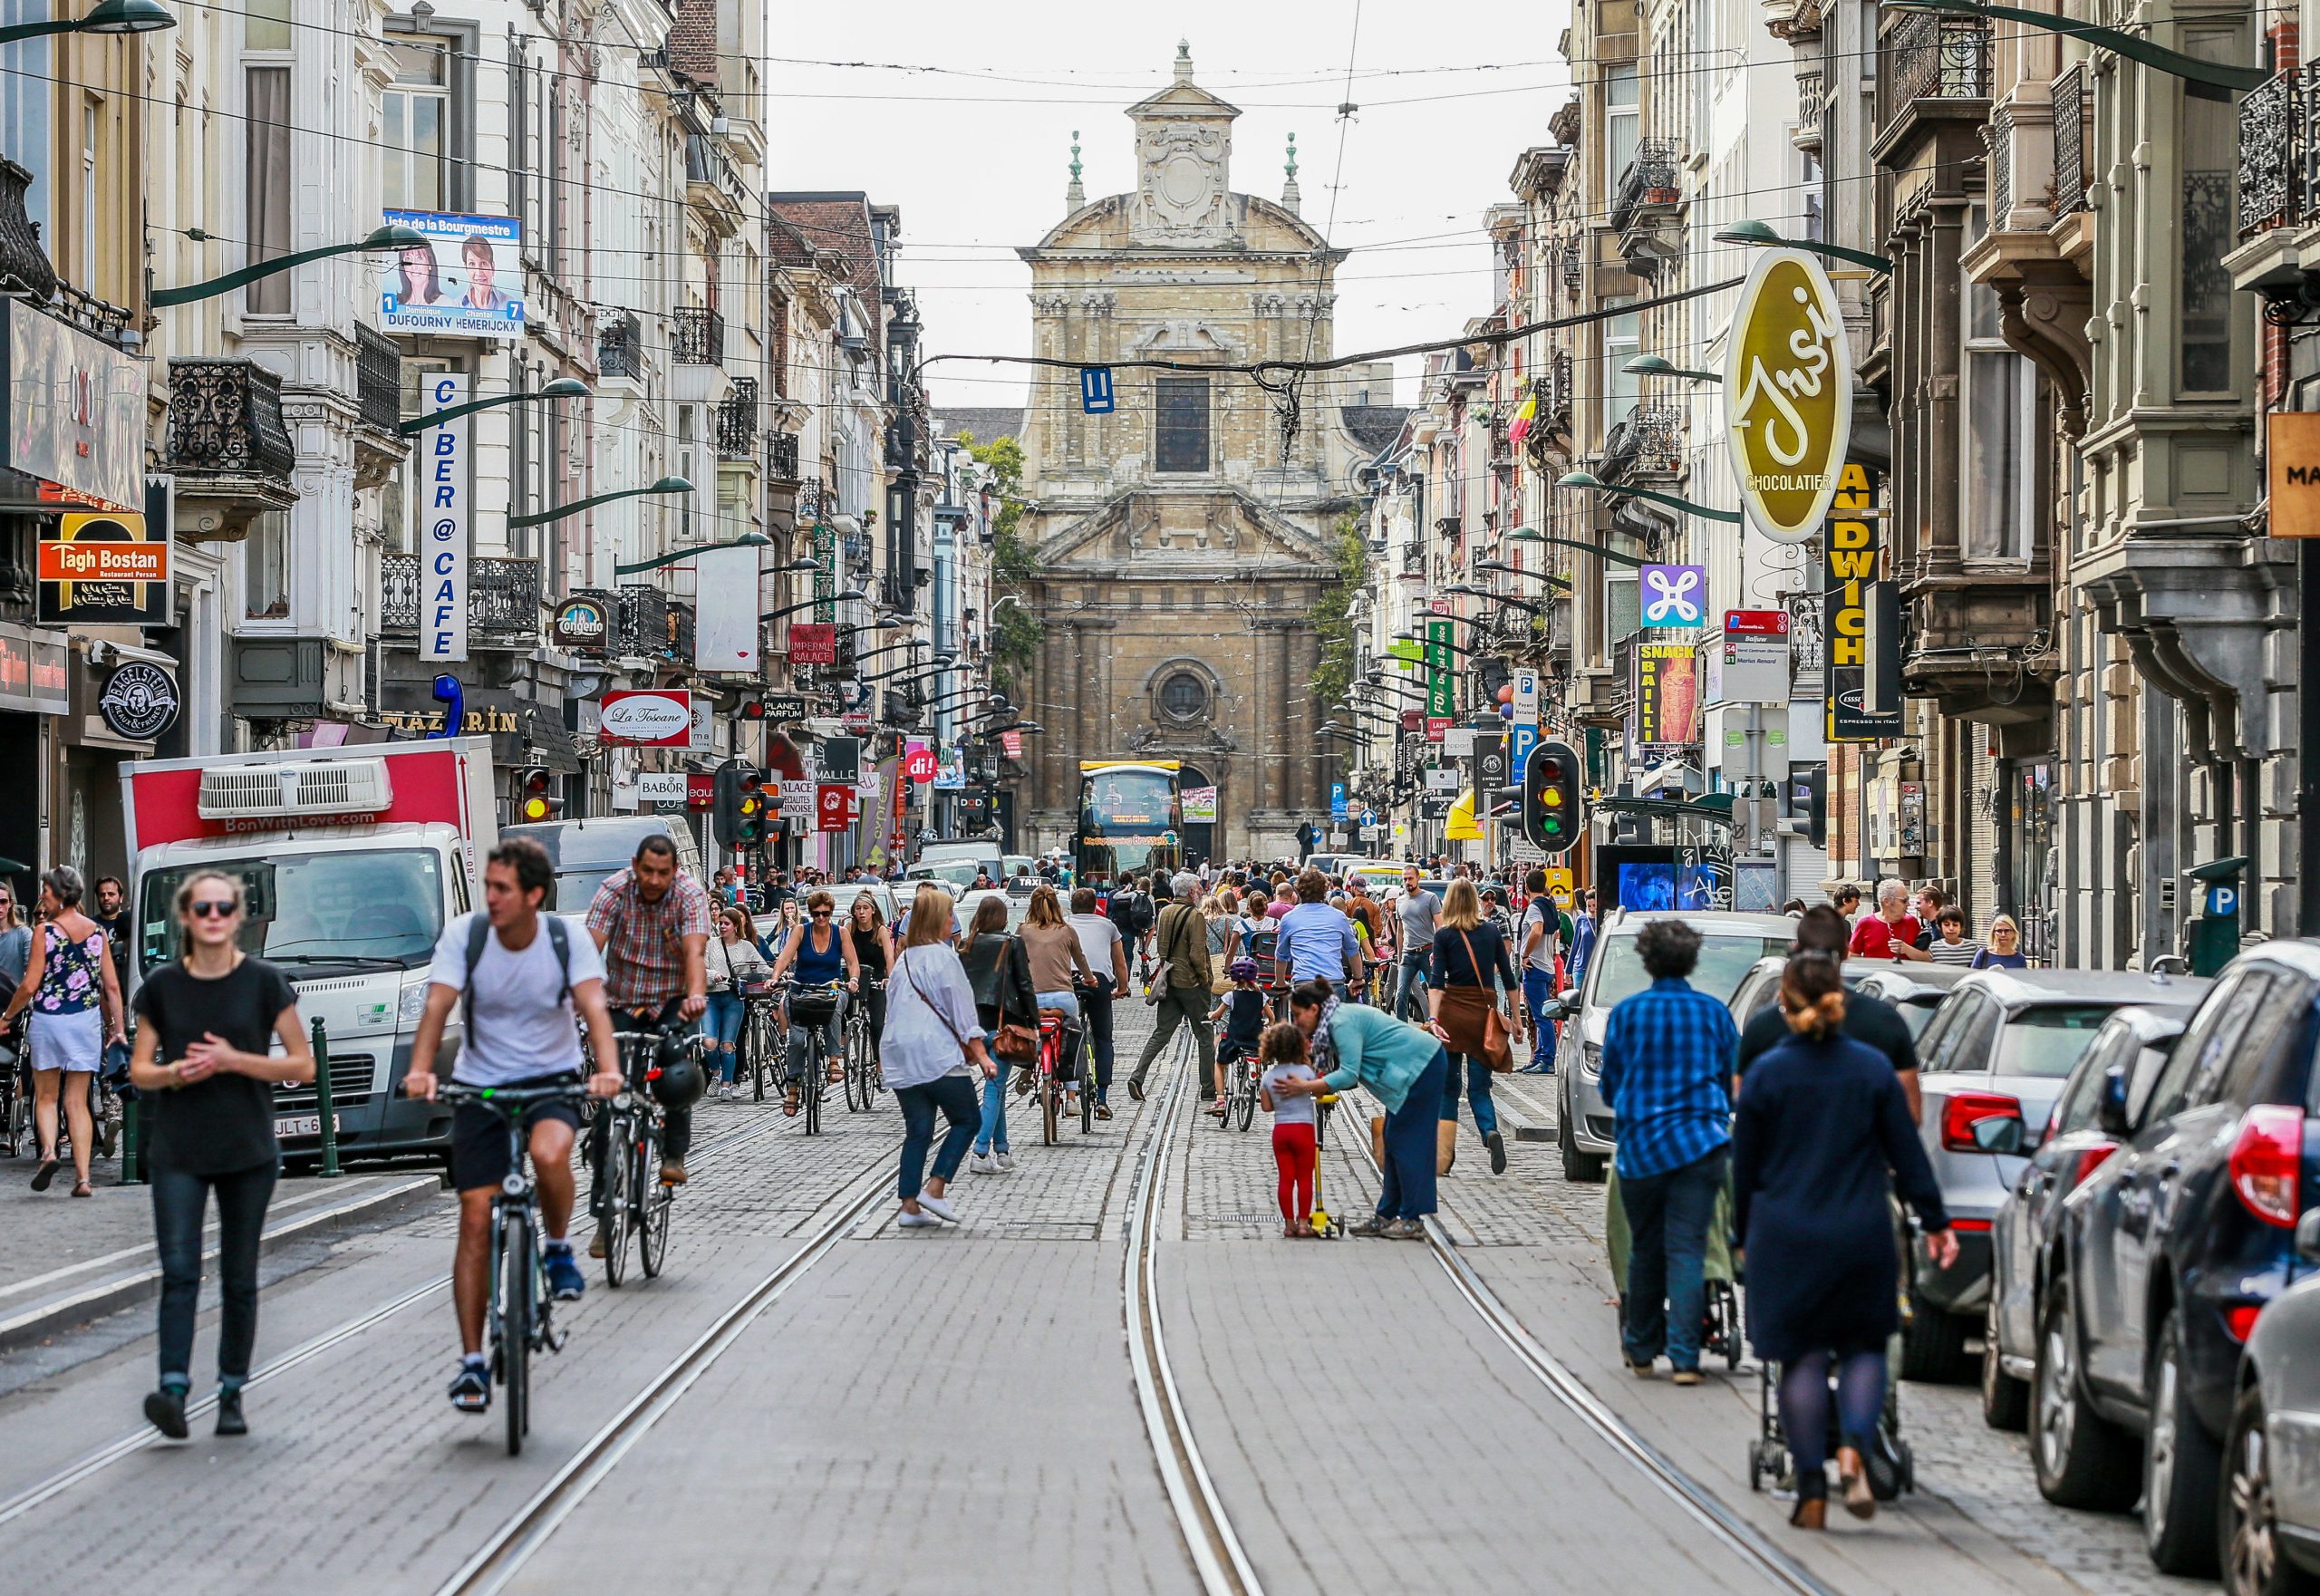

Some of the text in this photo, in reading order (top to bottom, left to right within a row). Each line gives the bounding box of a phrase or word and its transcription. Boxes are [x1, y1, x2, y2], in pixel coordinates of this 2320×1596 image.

[383, 216, 510, 236] Liste de la Bourgmestre
[384, 297, 392, 310] 1
[406, 306, 441, 315] Dominique
[510, 304, 519, 317] 7
[388, 314, 517, 333] DUFOURNY HEMERIJCKX
[1745, 475, 1832, 491] CHOCOLATIER
[433, 517, 456, 542] @
[50, 544, 158, 572] Tagh Bostan
[1829, 464, 1875, 664] ANDWICH
[433, 552, 455, 654] CAFE
[1437, 624, 1445, 655] Sevice
[1640, 645, 1696, 659] SNACK
[110, 667, 169, 697] BAGELSTEIN
[1522, 680, 1531, 692] P
[1641, 661, 1656, 741] BAILLI
[114, 705, 131, 726] BEAUX
[131, 719, 142, 730] &
[381, 705, 517, 732] MAZRIN
[609, 707, 682, 723] La Toscane
[764, 710, 802, 718] PARFUM
[1516, 730, 1534, 756] P
[910, 757, 933, 775] di!
[643, 782, 684, 794] BABOR
[782, 783, 813, 793] ALACE
[1333, 786, 1341, 798] P
[783, 795, 811, 804] ECIALITES
[782, 805, 813, 813] HINOISE
[225, 812, 375, 833] BonWithLove.com
[1019, 878, 1042, 886] TAXI
[2216, 889, 2235, 911] P
[275, 1117, 337, 1136] JLT-6
